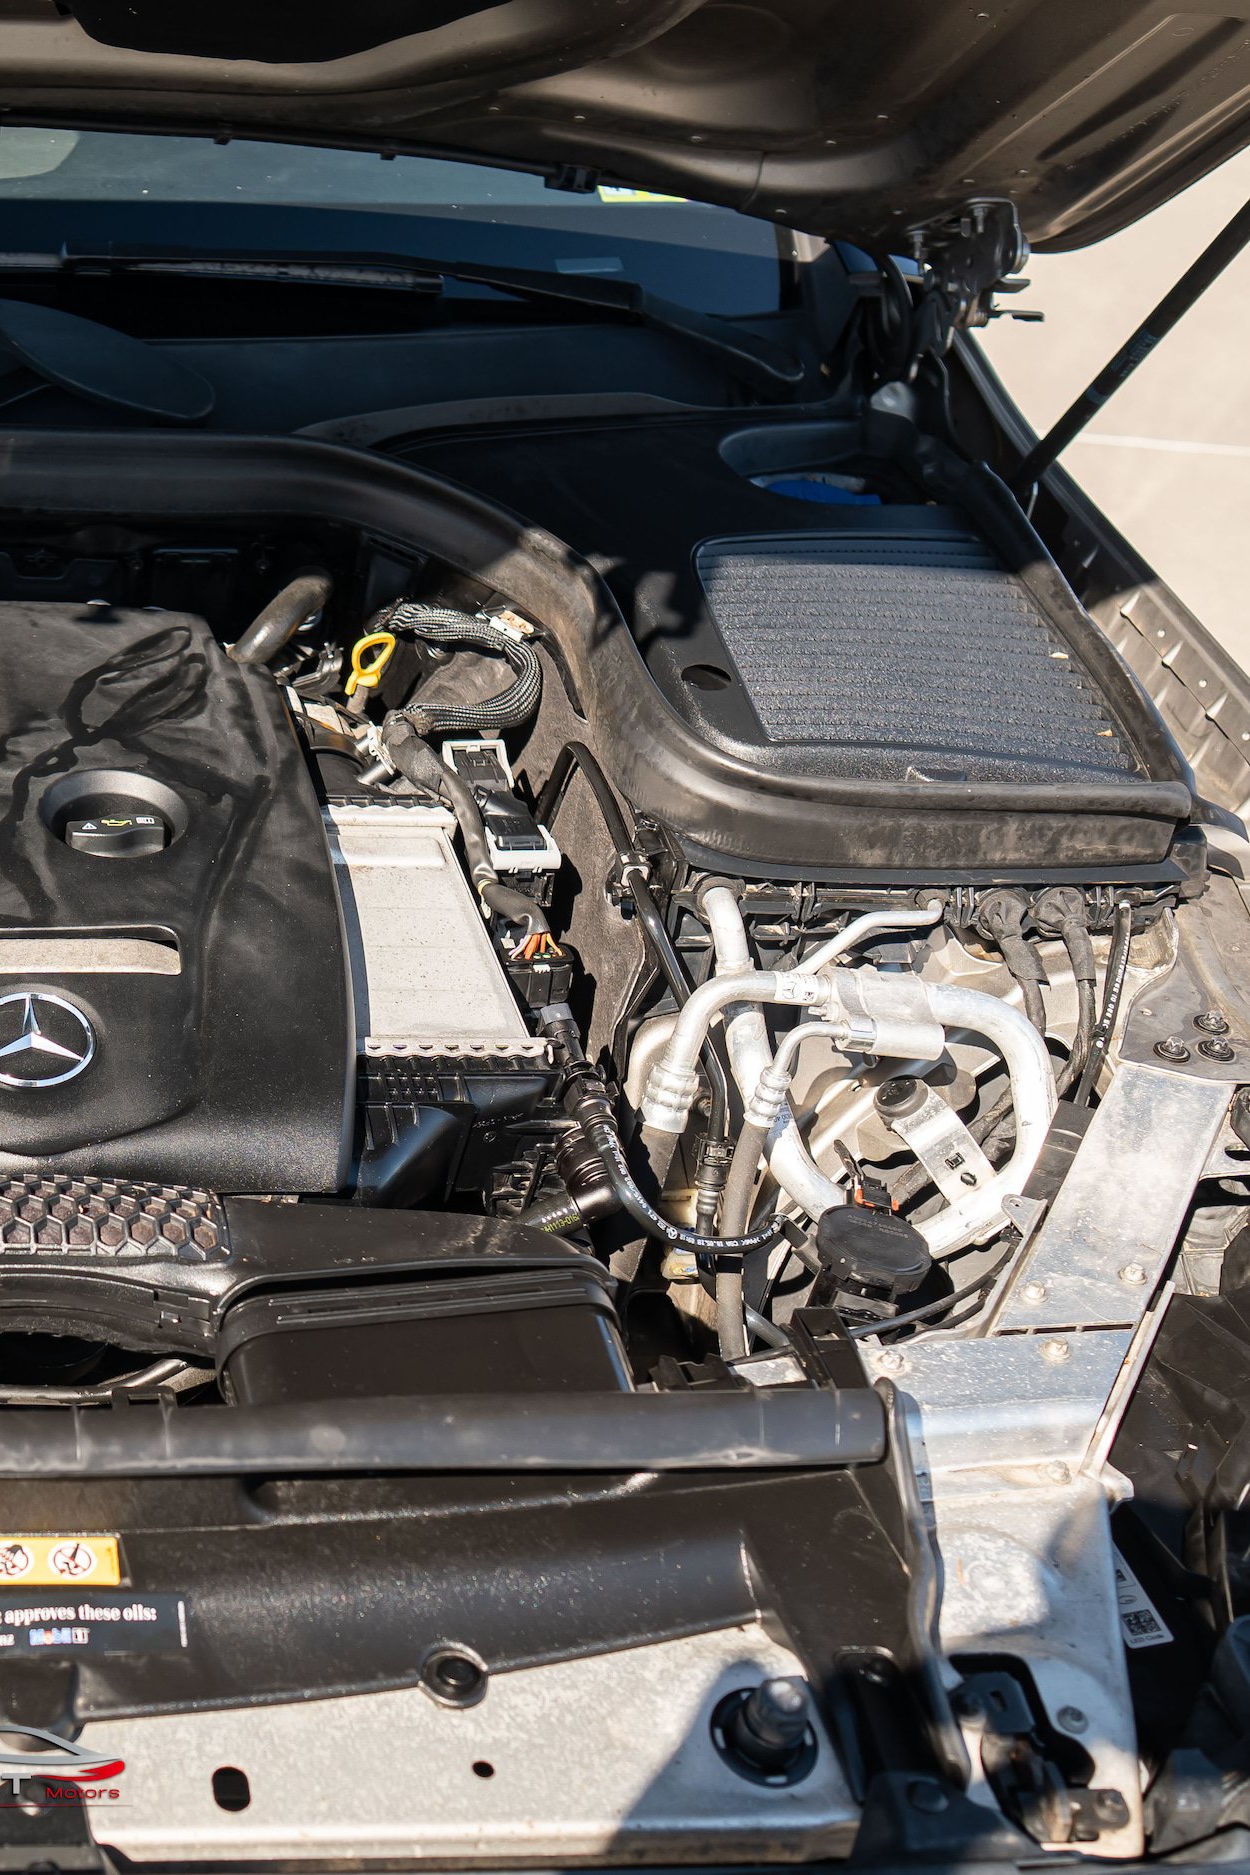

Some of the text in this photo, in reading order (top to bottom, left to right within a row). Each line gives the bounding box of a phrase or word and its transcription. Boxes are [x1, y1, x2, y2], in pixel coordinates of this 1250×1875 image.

[4, 1605, 76, 1627] approves
[78, 1603, 121, 1621] these
[29, 1627, 72, 1646] Mobil
